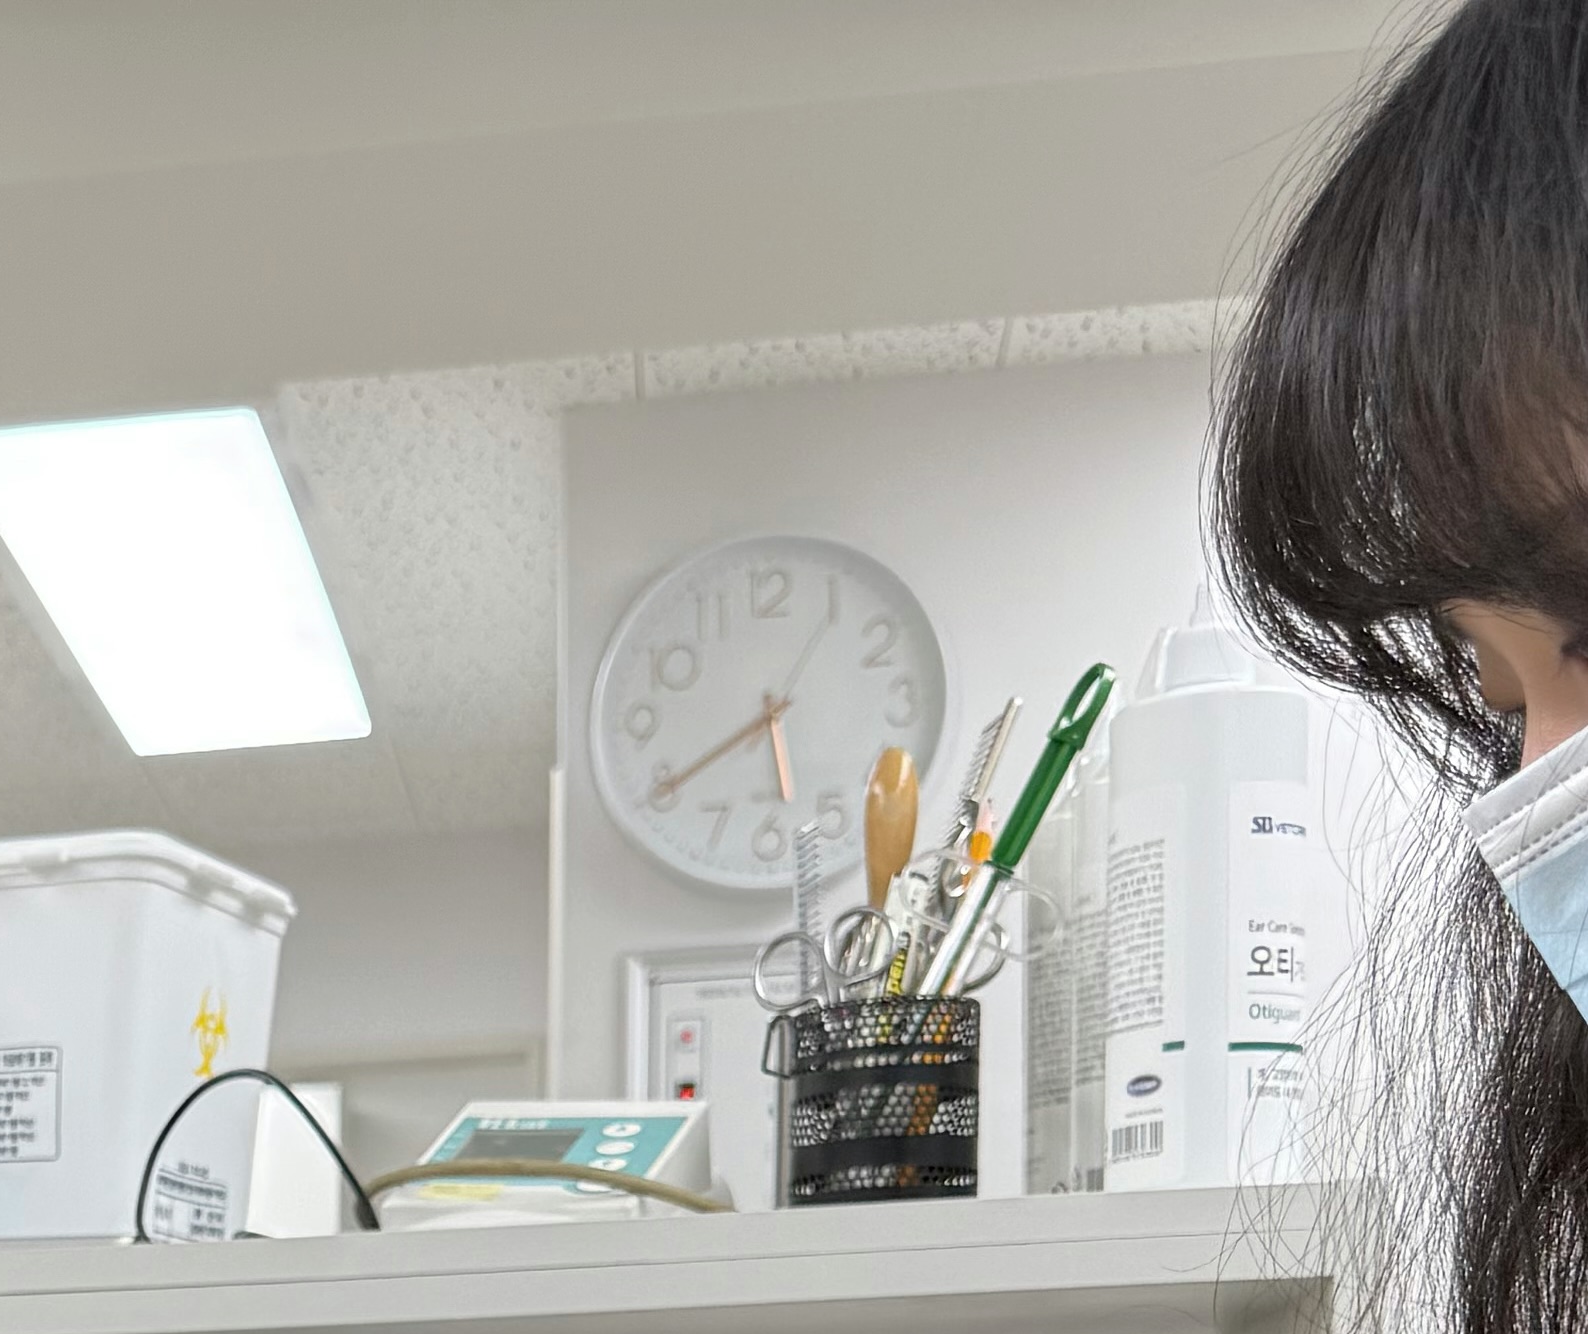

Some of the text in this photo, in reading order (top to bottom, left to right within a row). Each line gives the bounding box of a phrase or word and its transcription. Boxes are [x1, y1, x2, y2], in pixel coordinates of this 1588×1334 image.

[687, 583, 729, 643] 11
[749, 566, 796, 619] 12
[860, 615, 898, 670] 2
[625, 702, 659, 749] 9
[698, 803, 730, 850] 7
[750, 811, 789, 862] 6
[816, 788, 851, 839] 5
